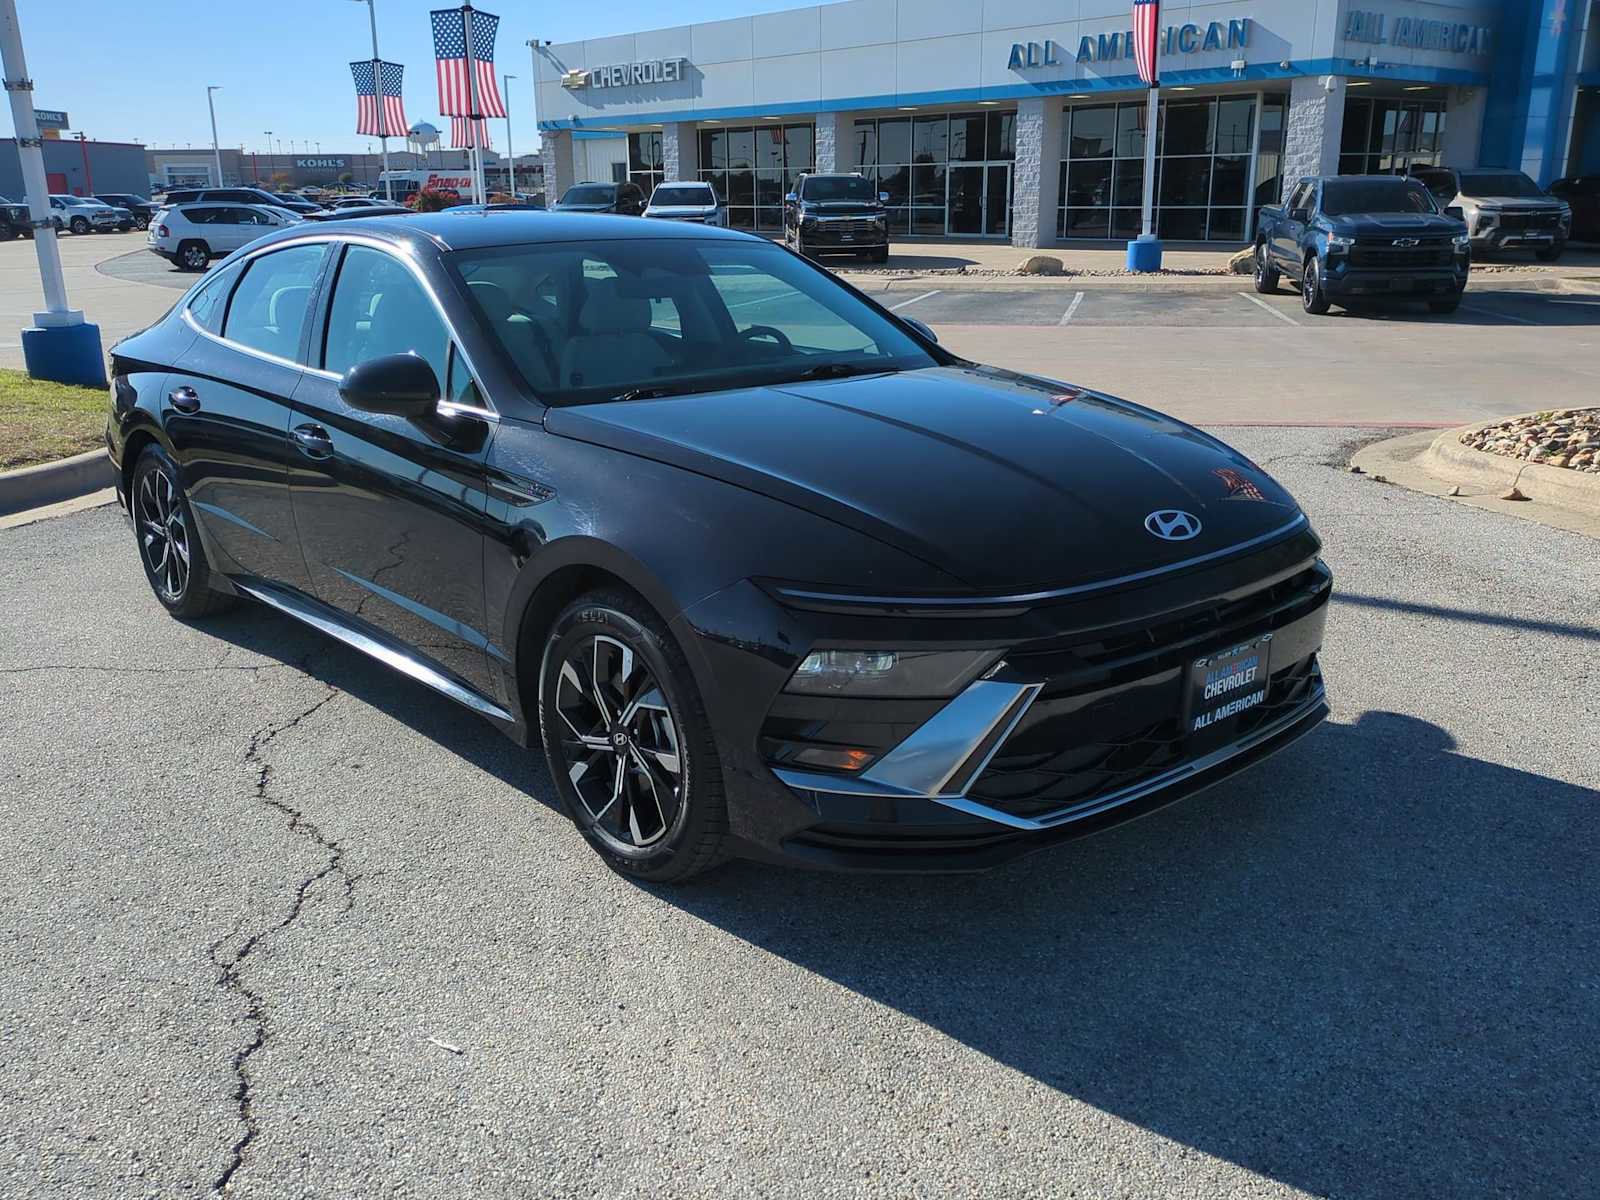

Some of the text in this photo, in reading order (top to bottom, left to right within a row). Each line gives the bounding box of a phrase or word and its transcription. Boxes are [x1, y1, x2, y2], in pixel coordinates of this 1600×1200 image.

[1008, 18, 1250, 69] ALL AMEICAN
[591, 58, 685, 88] CHEVROLET
[297, 159, 345, 168] KOHL'S
[1204, 666, 1257, 699] CHEVROLET
[1194, 690, 1264, 731] ALL AMERICAN
